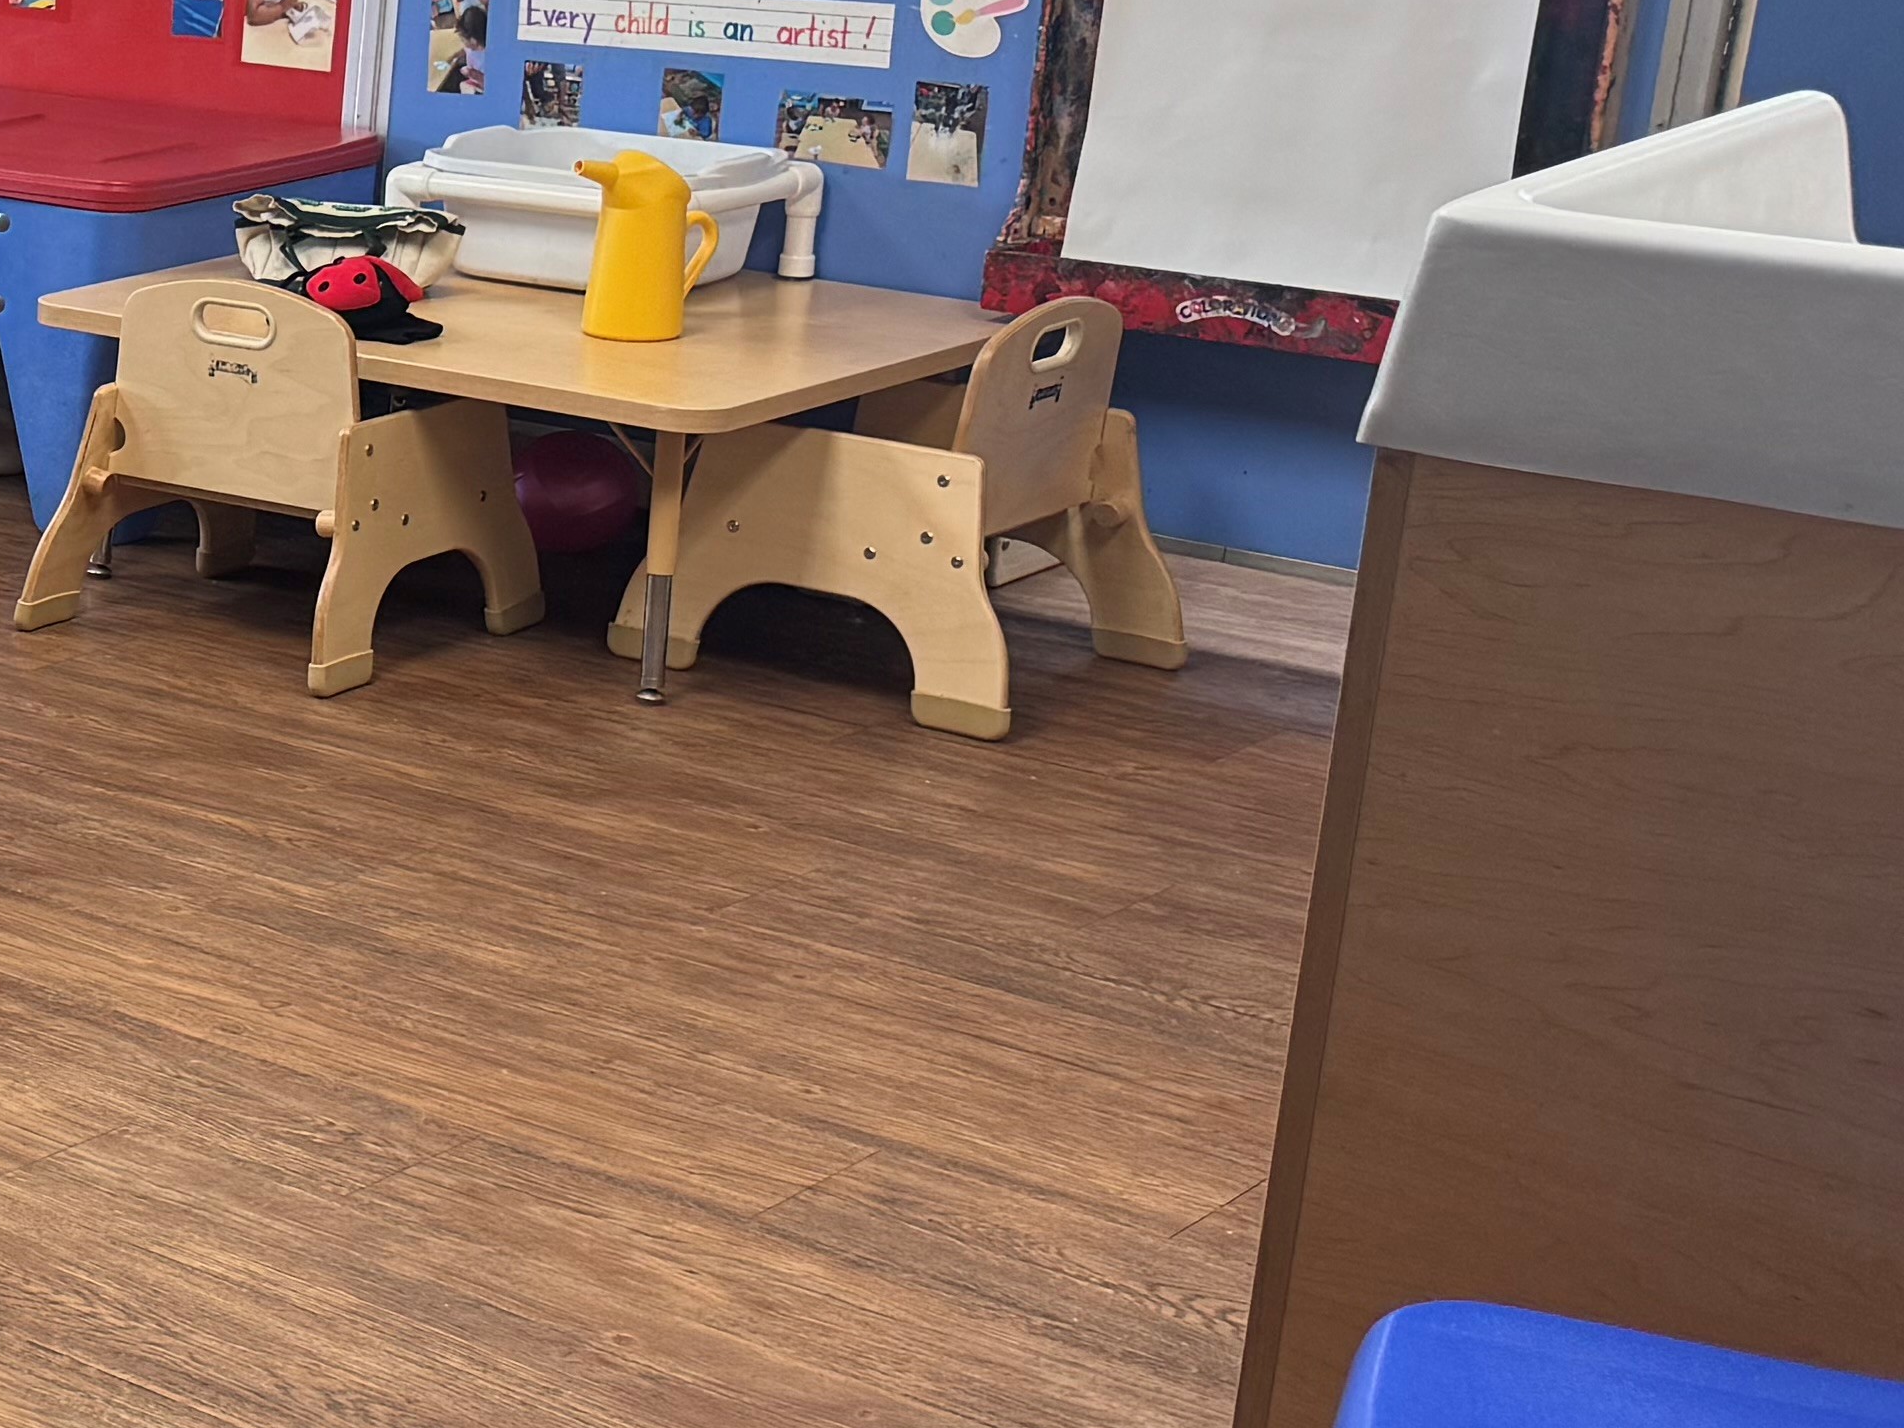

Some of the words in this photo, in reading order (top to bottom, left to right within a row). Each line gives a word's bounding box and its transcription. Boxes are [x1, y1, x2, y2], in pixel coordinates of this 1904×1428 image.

[613, 0, 671, 36] child
[687, 10, 706, 38] is
[722, 20, 754, 42] an
